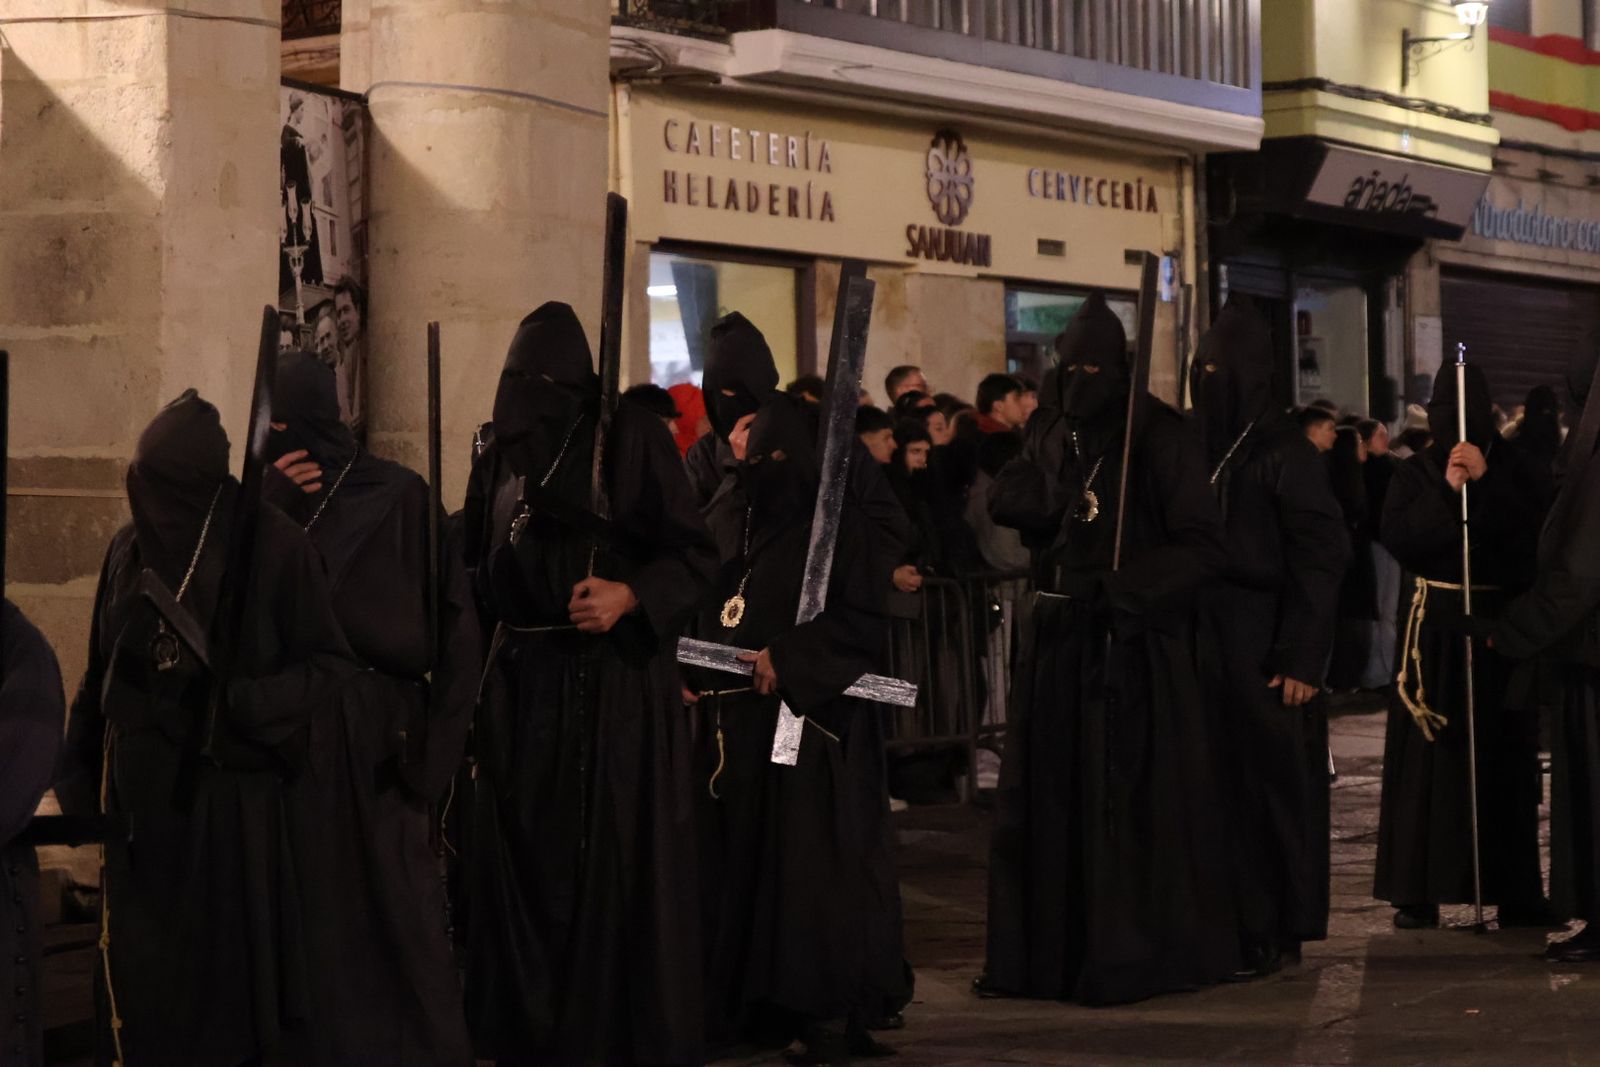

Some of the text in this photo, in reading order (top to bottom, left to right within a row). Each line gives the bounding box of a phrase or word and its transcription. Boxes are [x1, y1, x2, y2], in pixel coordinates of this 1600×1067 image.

[663, 118, 832, 174] CAFETERÍA
[663, 169, 835, 222] HELADERÍA
[1028, 167, 1158, 214] CERVECERÍA
